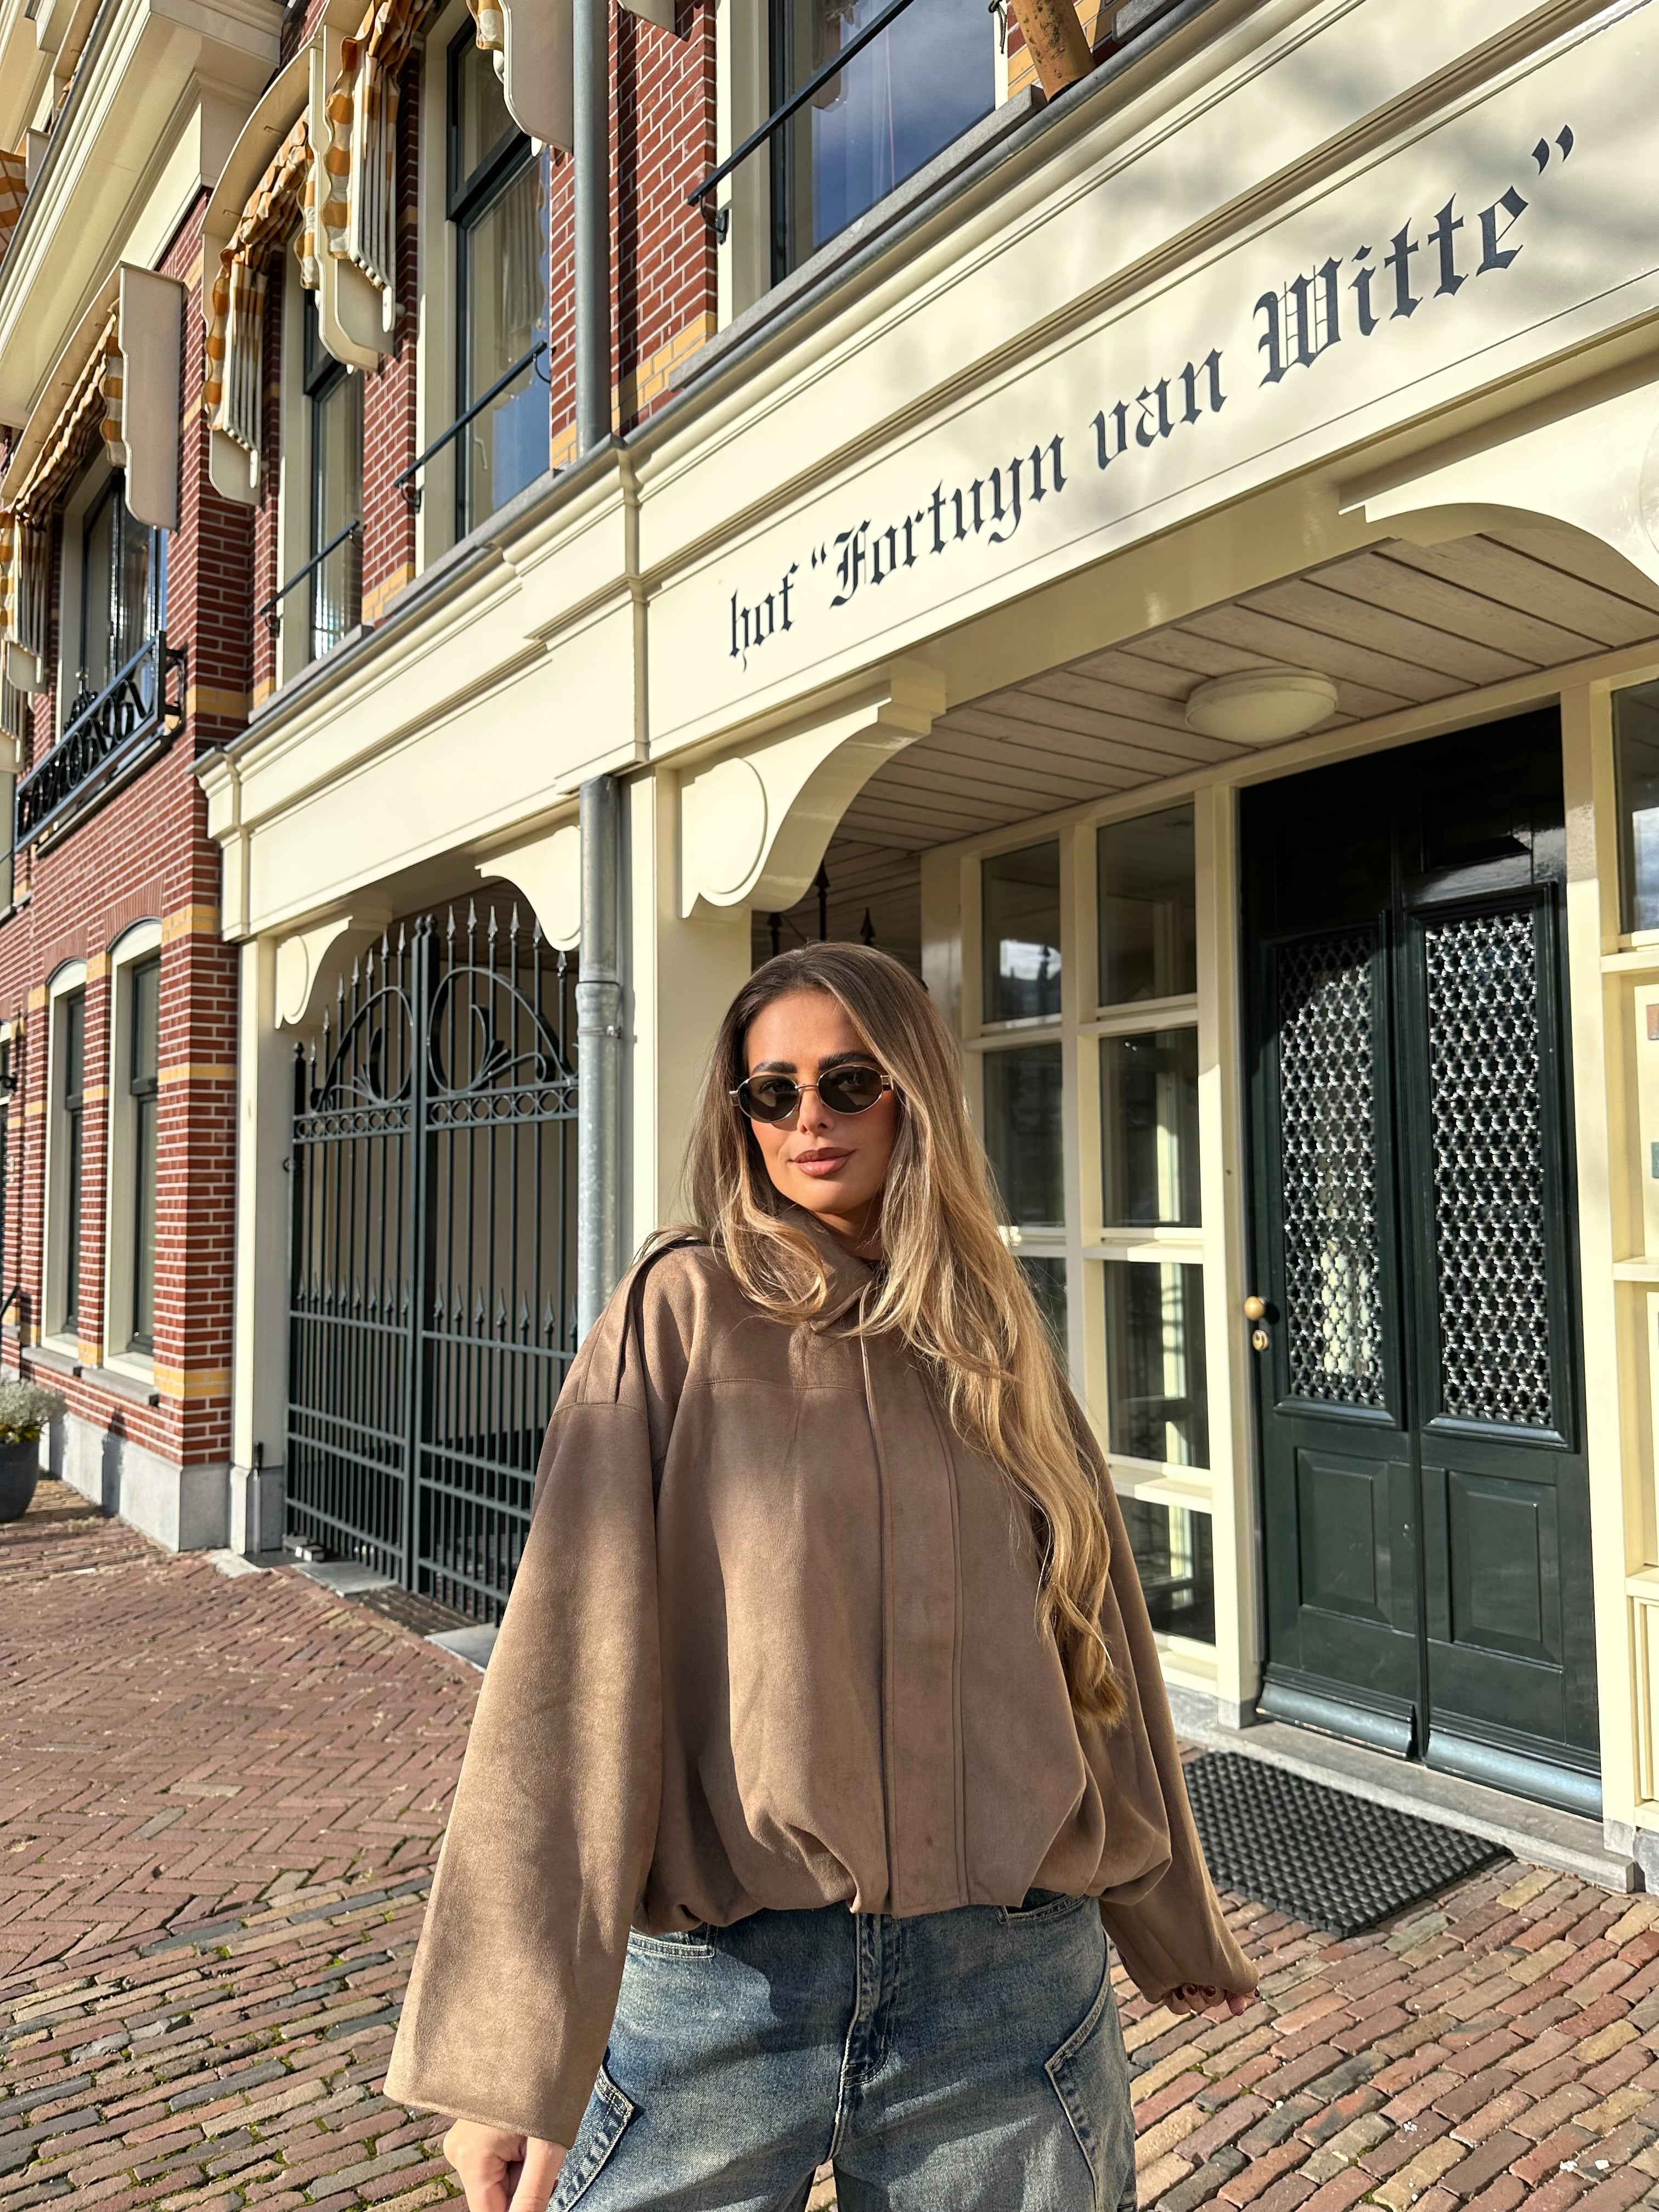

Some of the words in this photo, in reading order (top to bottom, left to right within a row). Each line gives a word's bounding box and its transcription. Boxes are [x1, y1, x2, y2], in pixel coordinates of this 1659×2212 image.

[729, 562, 799, 672] hof
[1090, 348, 1228, 471] van
[1252, 124, 1574, 387] Witte”
